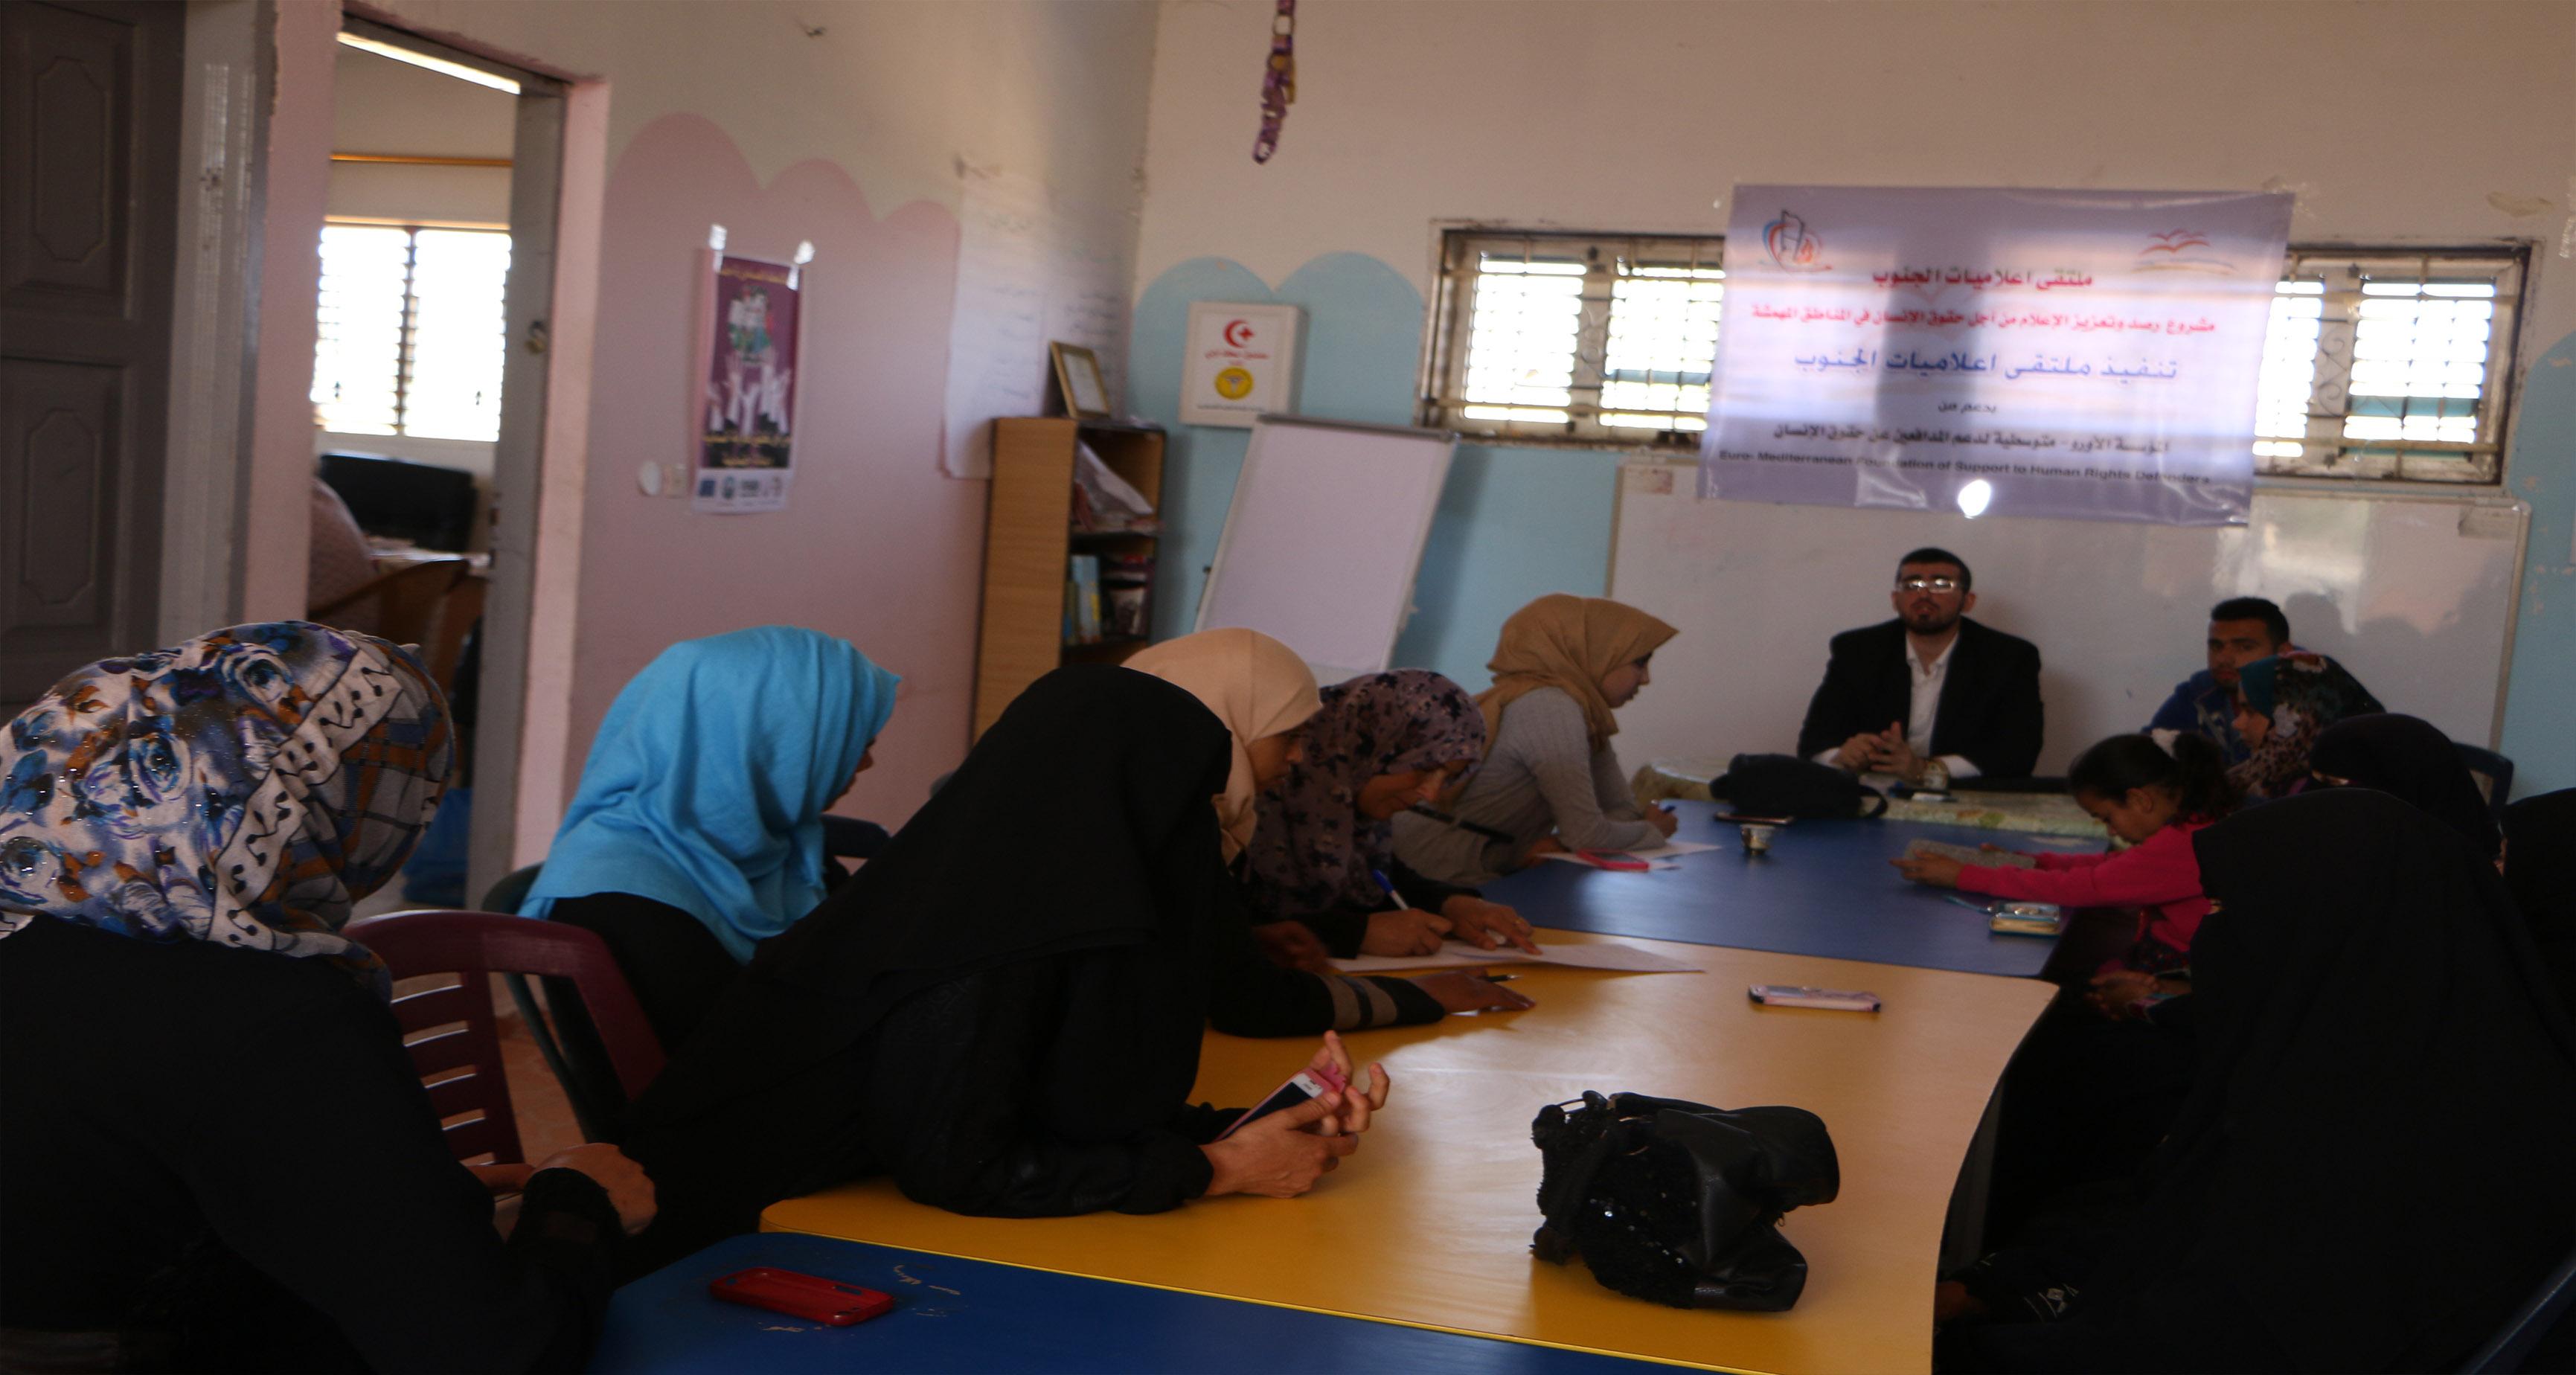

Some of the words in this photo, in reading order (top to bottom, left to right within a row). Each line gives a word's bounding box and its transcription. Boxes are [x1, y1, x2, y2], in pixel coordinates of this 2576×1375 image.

[1873, 266, 1941, 289] الجنوب
[2036, 268, 2092, 290] ملتقى
[1795, 348, 1877, 373] الجنوب
[1886, 350, 1997, 377] اعلاميات
[2005, 353, 2091, 380] ملتقى
[2101, 356, 2177, 385] تنفيذ
[1719, 449, 1753, 461] Euro-
[1757, 452, 1853, 466] Mediterranean
[1937, 459, 1951, 470] of
[1955, 460, 2009, 475] Support
[2013, 464, 2026, 475] to
[2031, 464, 2081, 478] Human
[2085, 467, 2130, 482] Rights
